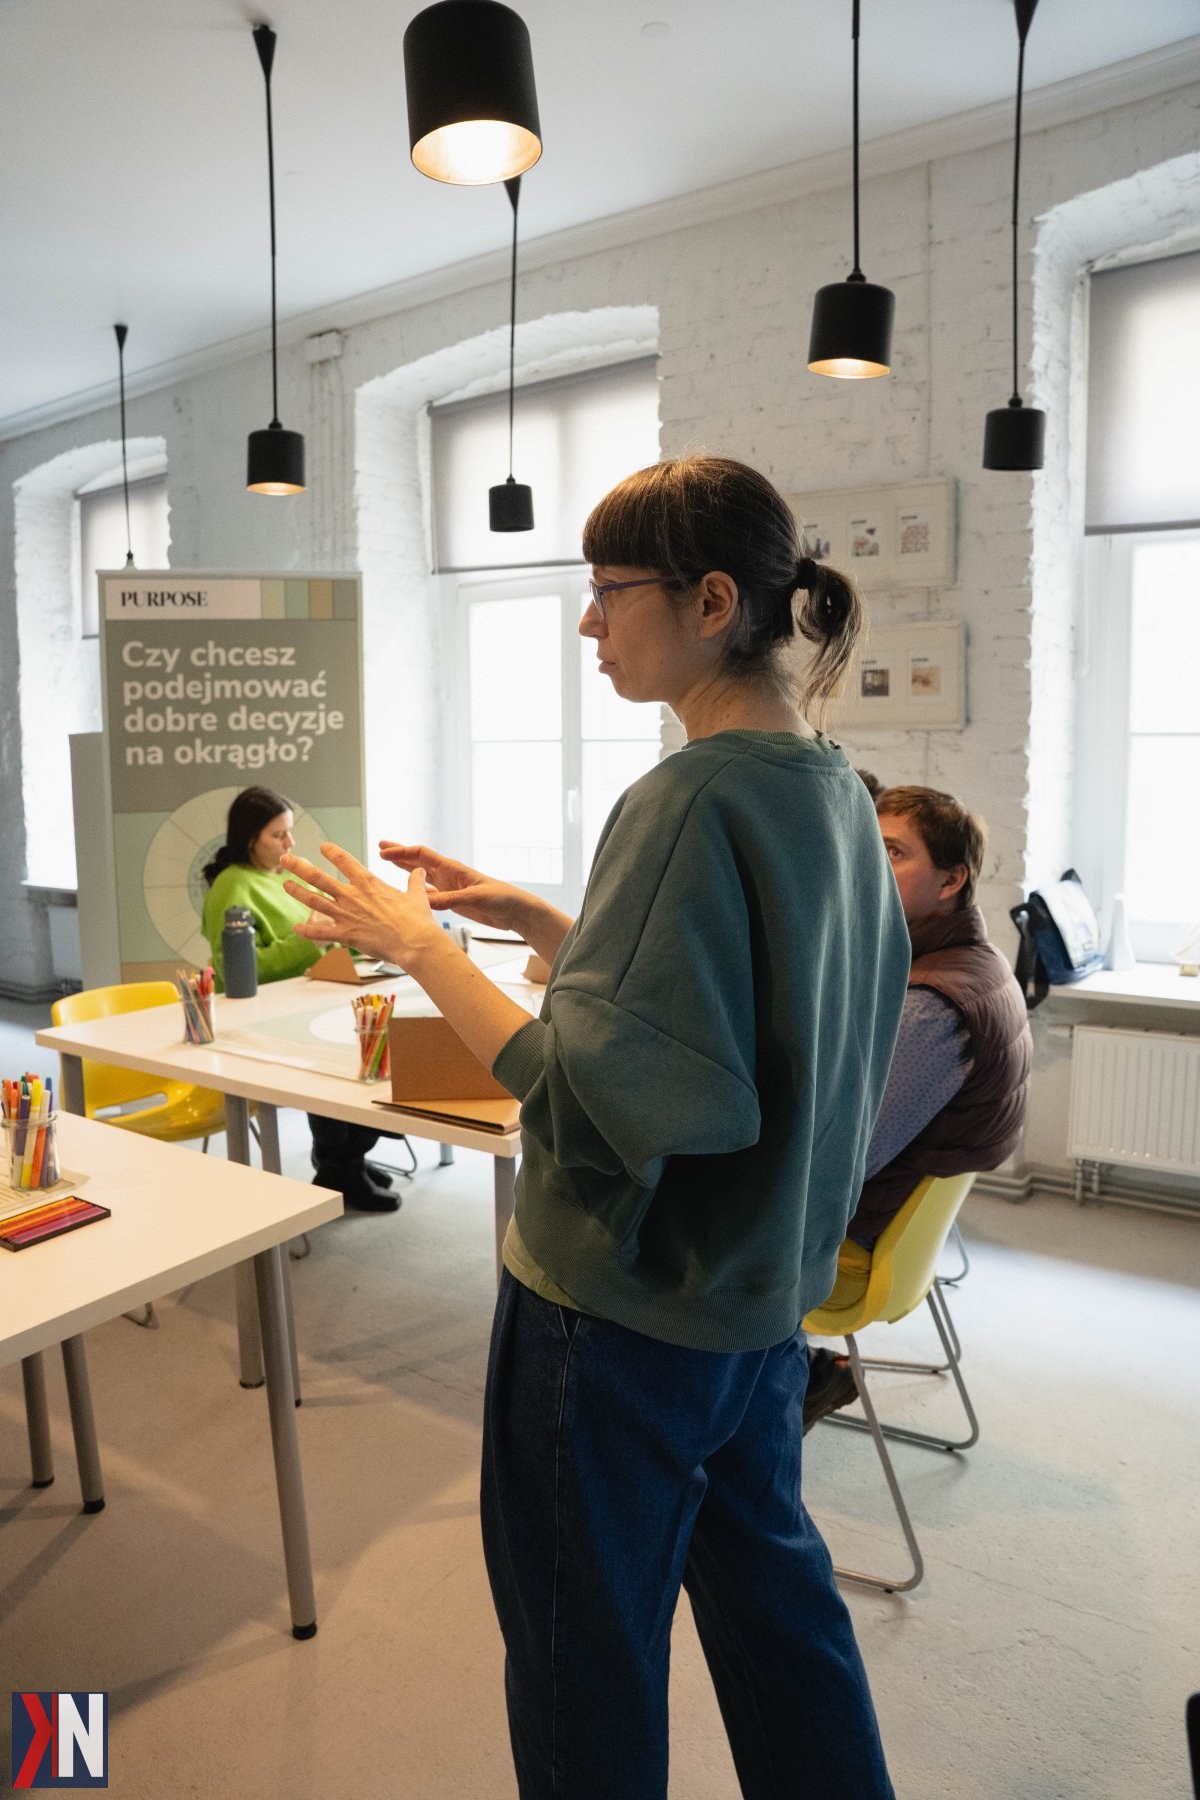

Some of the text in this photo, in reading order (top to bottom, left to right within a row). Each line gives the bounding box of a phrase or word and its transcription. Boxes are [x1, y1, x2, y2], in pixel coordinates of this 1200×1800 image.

[121, 591, 208, 607] PURPOSE
[122, 640, 296, 673] Czy chcesz
[123, 670, 327, 705] podejmować
[124, 704, 344, 736] dobre decyzje
[125, 737, 314, 769] na okrągło?
